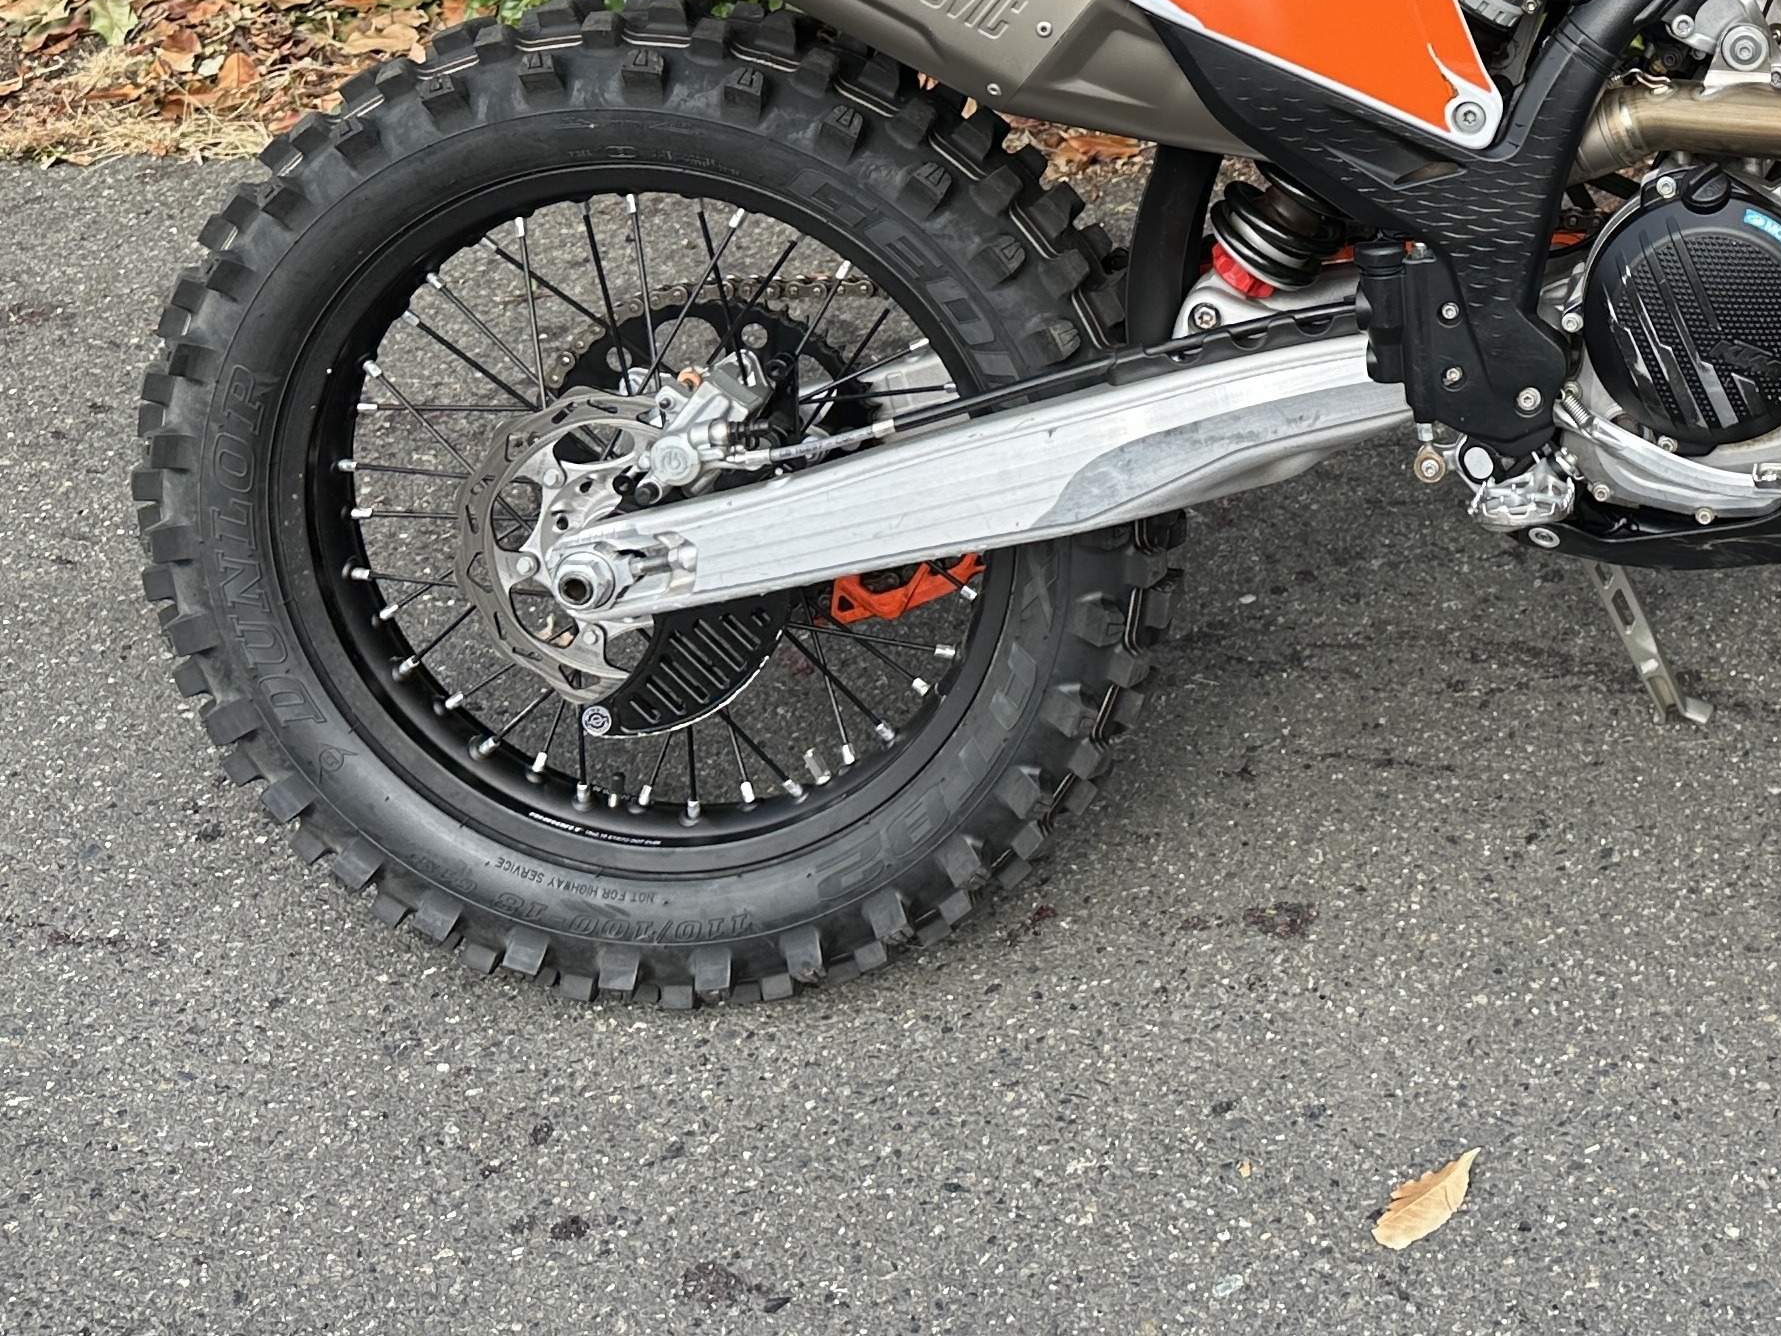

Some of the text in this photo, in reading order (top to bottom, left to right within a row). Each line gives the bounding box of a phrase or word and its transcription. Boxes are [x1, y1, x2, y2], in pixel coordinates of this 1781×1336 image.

[209, 363, 326, 729] DUNLOP
[493, 854, 545, 884] SERVICE
[601, 886, 626, 901] FOR
[630, 889, 653, 902] NOT
